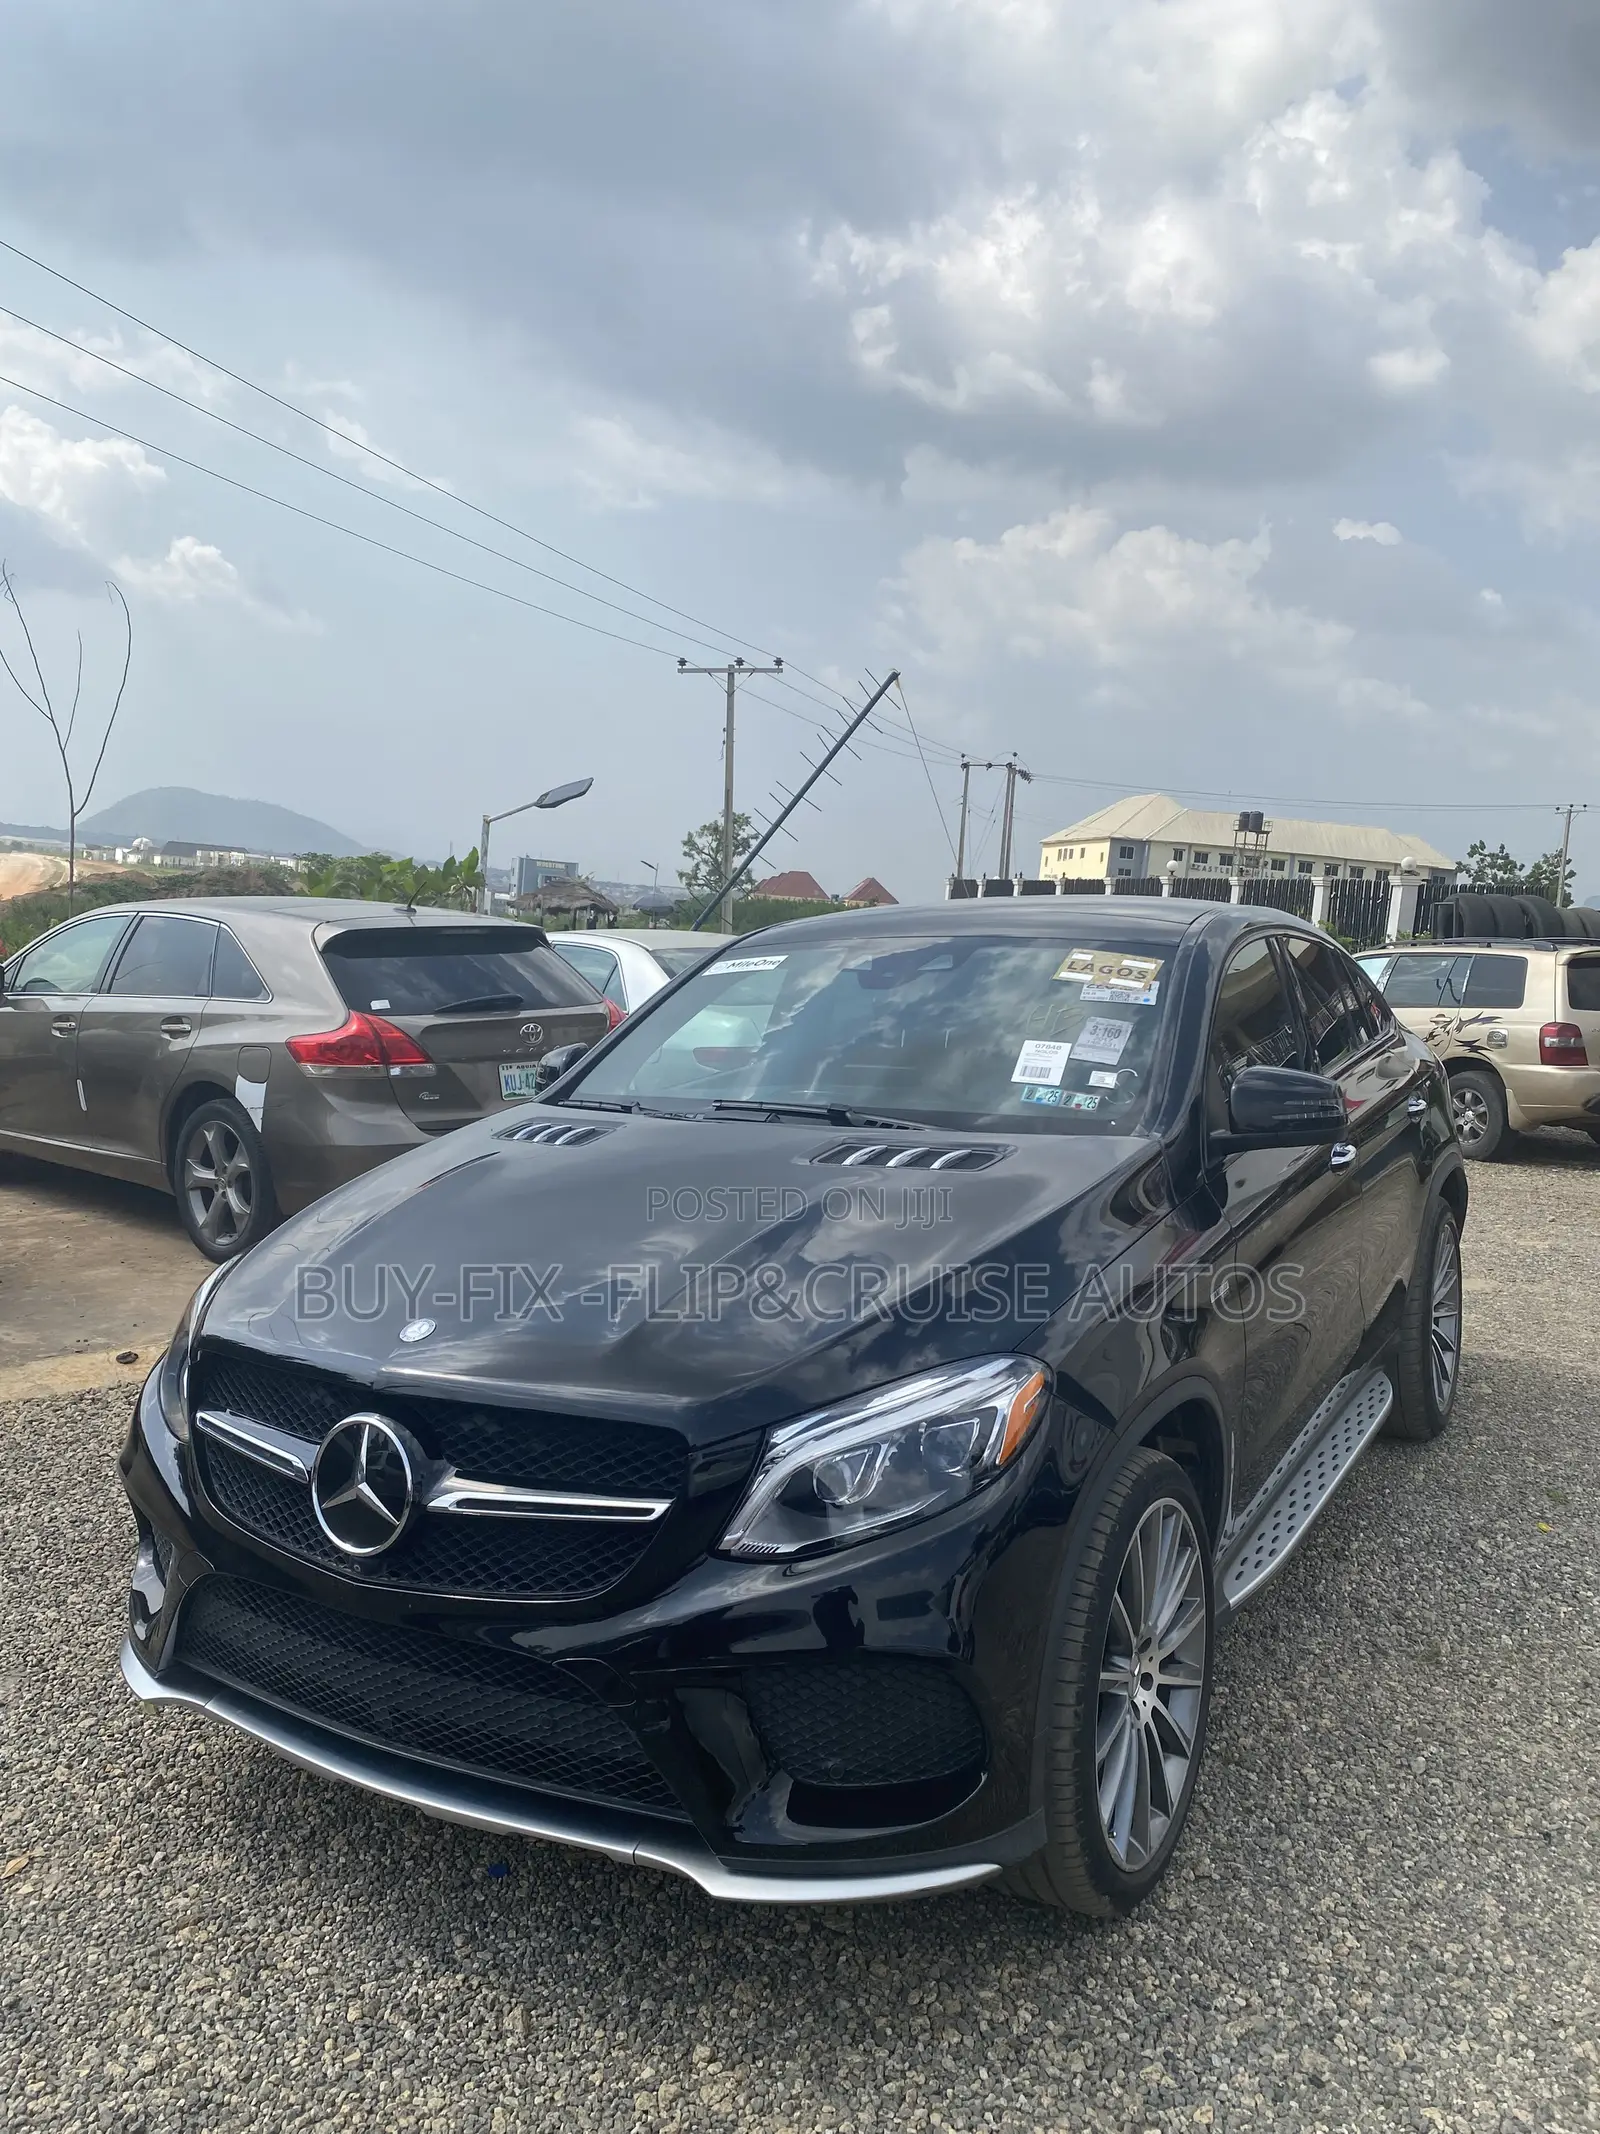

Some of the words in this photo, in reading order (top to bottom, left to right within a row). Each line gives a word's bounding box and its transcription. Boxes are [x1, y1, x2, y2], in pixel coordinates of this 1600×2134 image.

[727, 959, 781, 969] MileOne
[1067, 960, 1149, 980] LAGOS
[504, 1073, 536, 1092] KUJ-42
[1026, 1090, 1034, 1100] 2
[1047, 1090, 1060, 1103] 25
[1063, 1095, 1072, 1106] 2
[1086, 1096, 1099, 1109] 25
